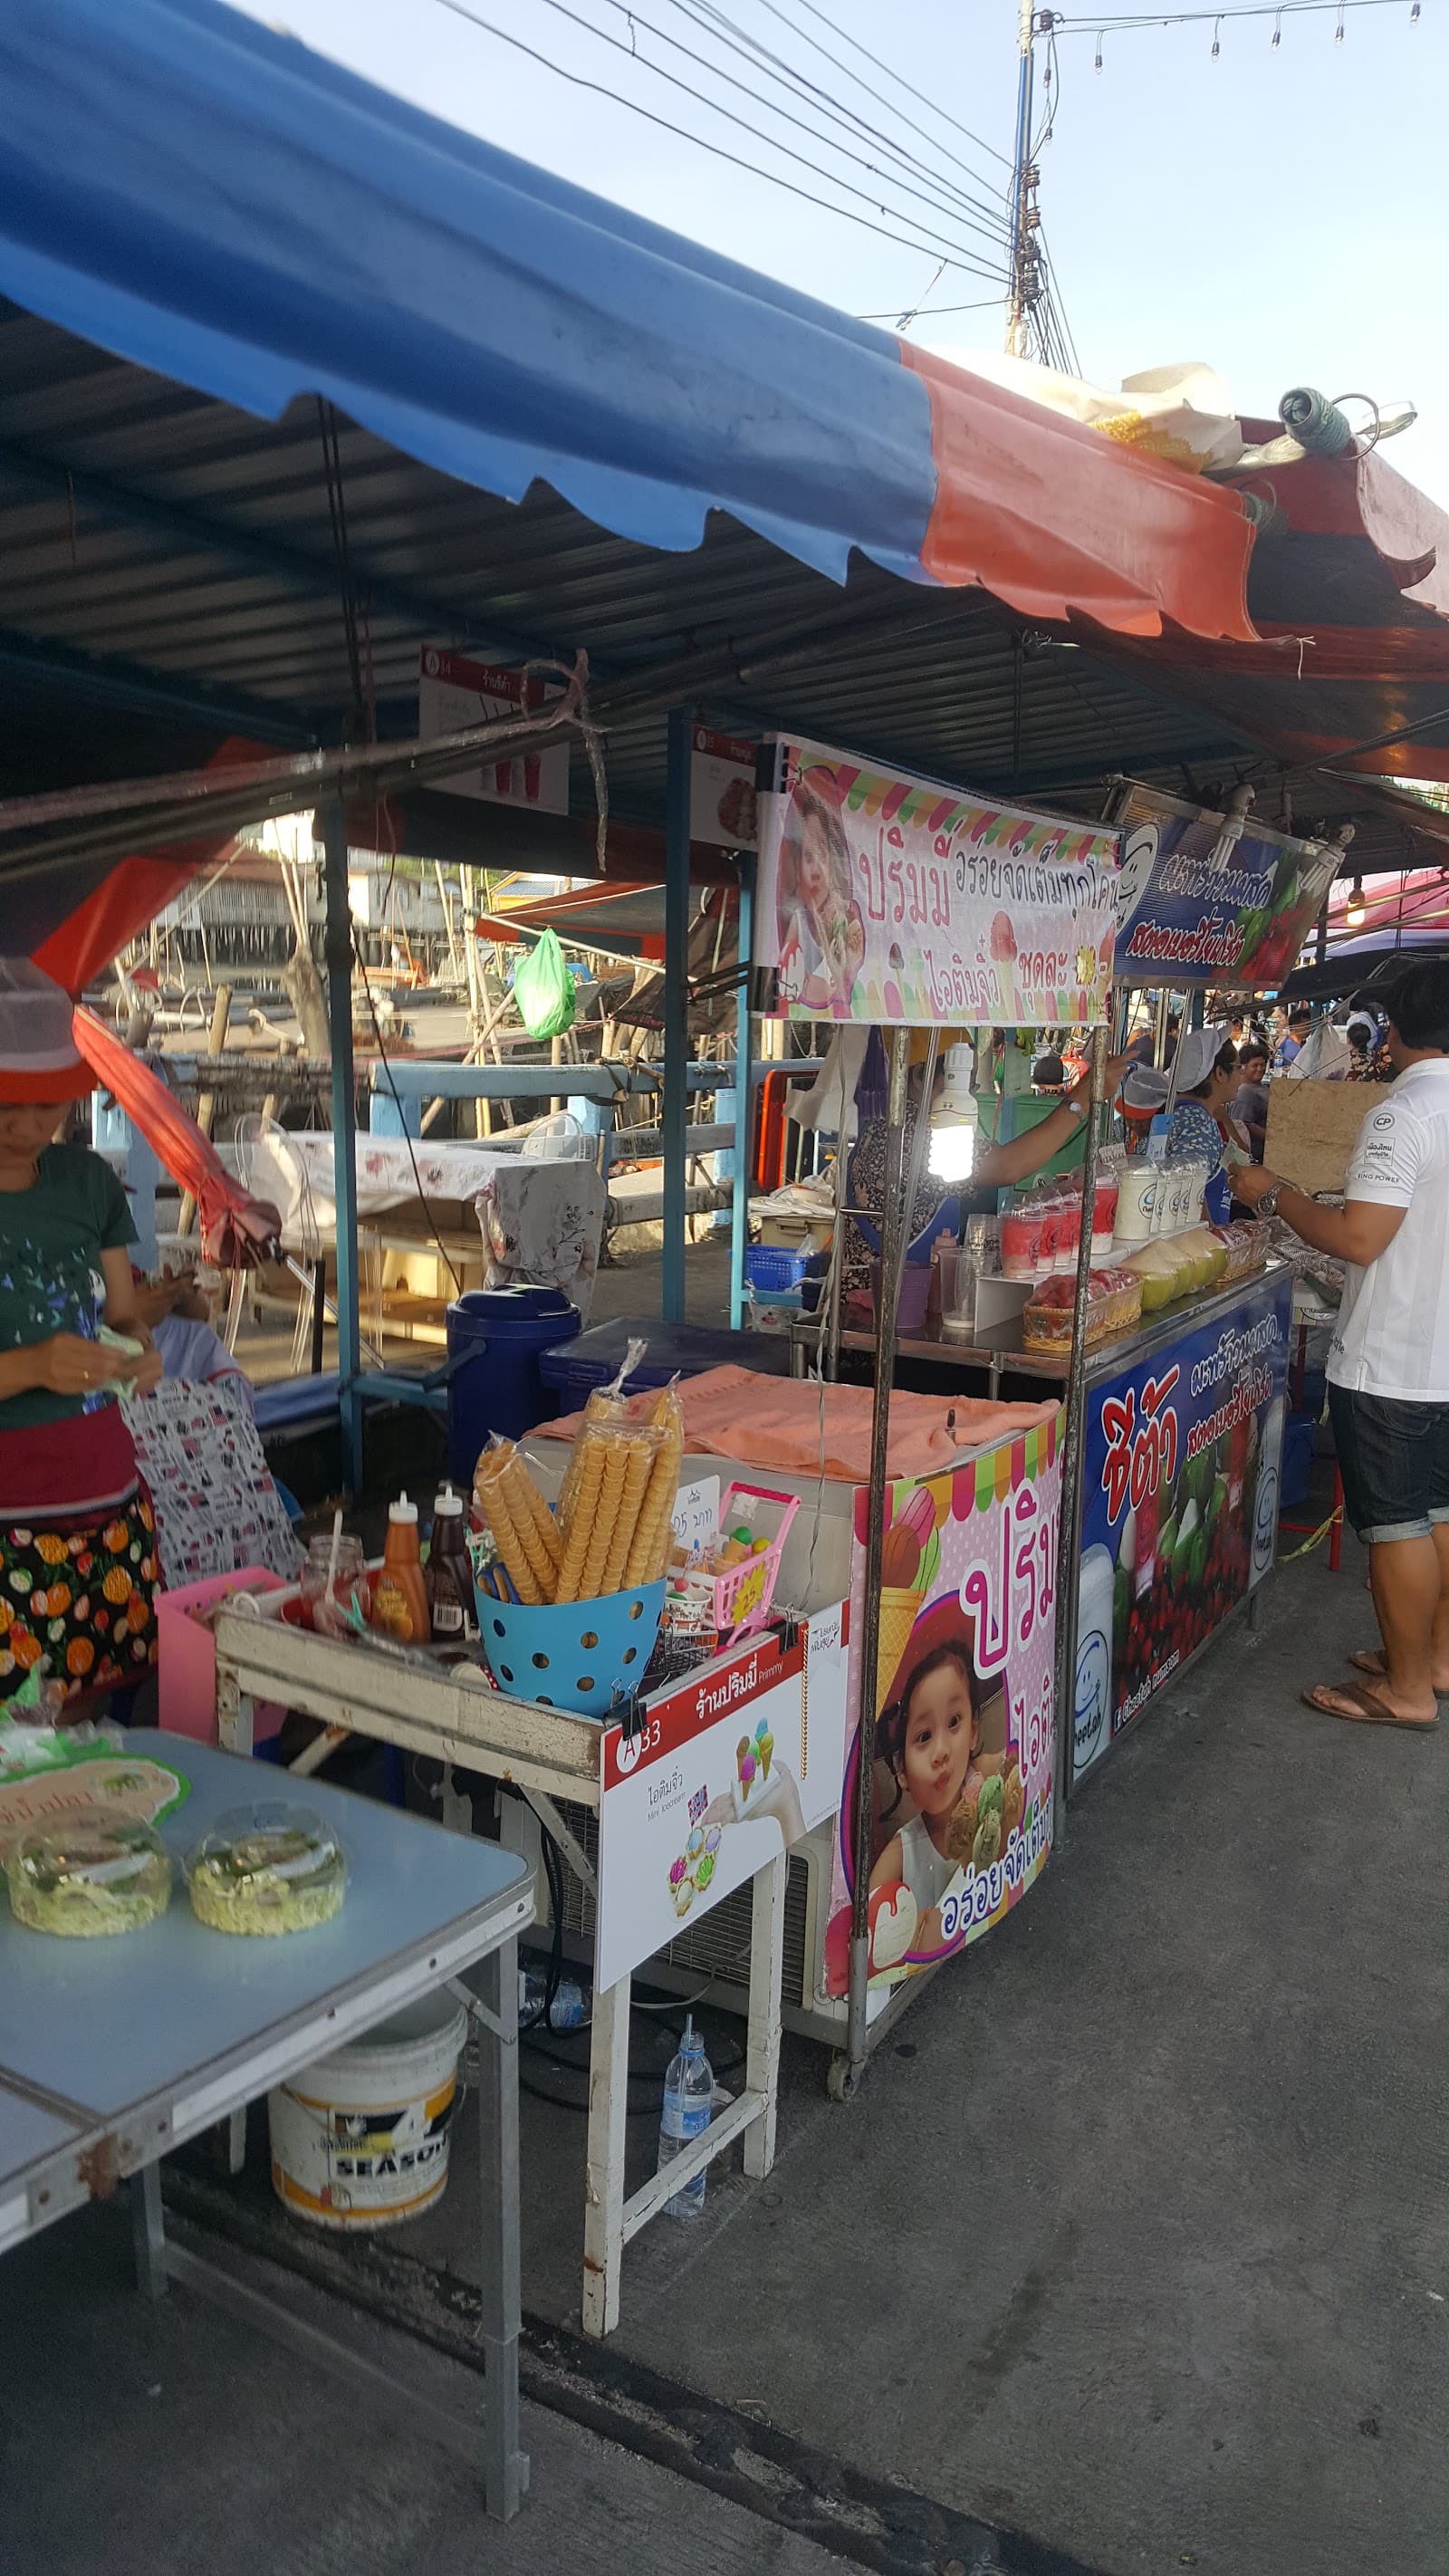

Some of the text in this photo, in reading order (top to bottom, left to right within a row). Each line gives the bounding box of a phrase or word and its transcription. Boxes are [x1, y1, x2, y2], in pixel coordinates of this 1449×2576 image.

[859, 819, 964, 928] ปริมมี่
[1018, 951, 1069, 1013] ชุดละ
[1376, 1117, 1392, 1126] CP
[696, 1653, 784, 1719] ร้านปริมมี่ Primmy
[640, 1719, 661, 1753] 33
